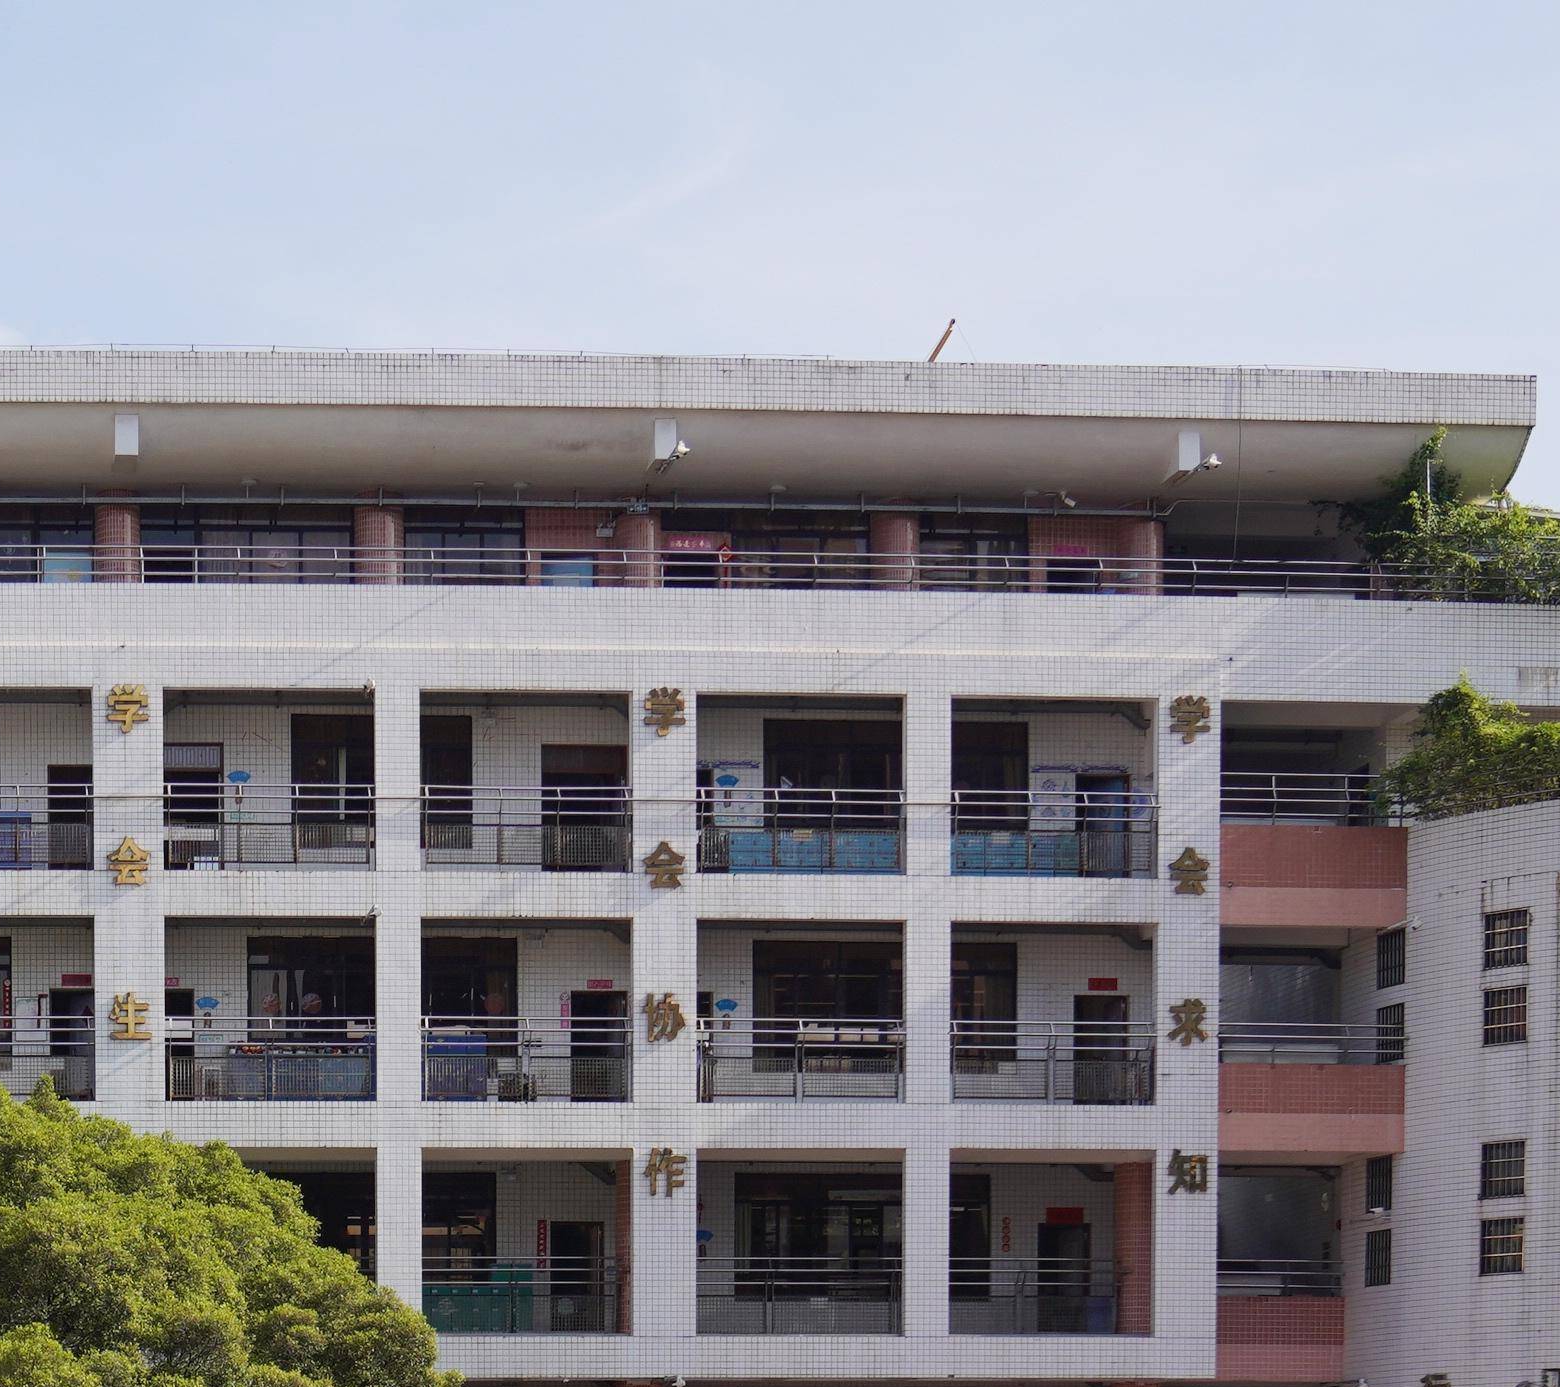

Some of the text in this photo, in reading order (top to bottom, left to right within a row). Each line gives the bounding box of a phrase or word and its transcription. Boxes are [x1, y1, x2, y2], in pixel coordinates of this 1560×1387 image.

[642, 686, 687, 1200] 学会协作
[1168, 694, 1211, 1195] 学会求知
